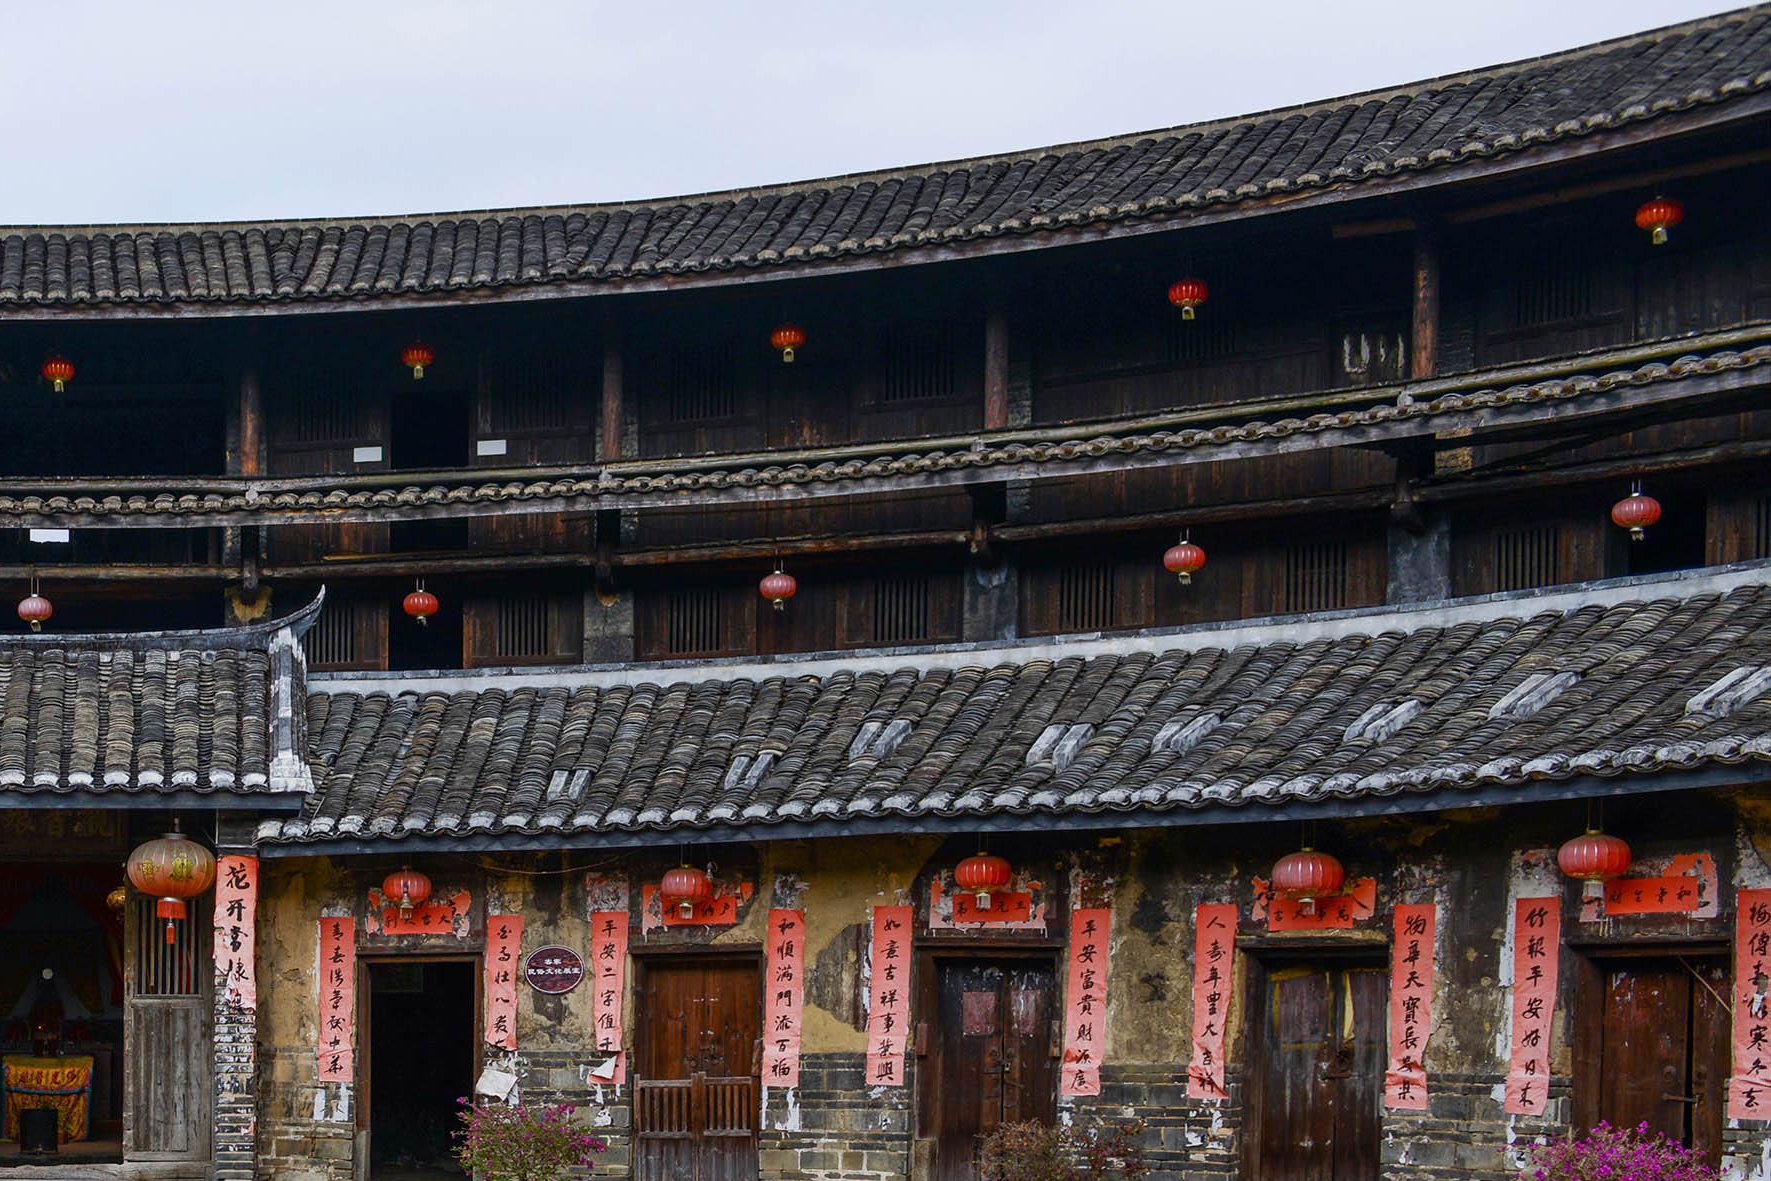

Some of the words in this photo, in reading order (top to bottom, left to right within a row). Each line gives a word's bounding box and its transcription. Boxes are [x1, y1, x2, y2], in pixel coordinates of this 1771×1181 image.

[597, 919, 619, 1054] 平安二字值千
